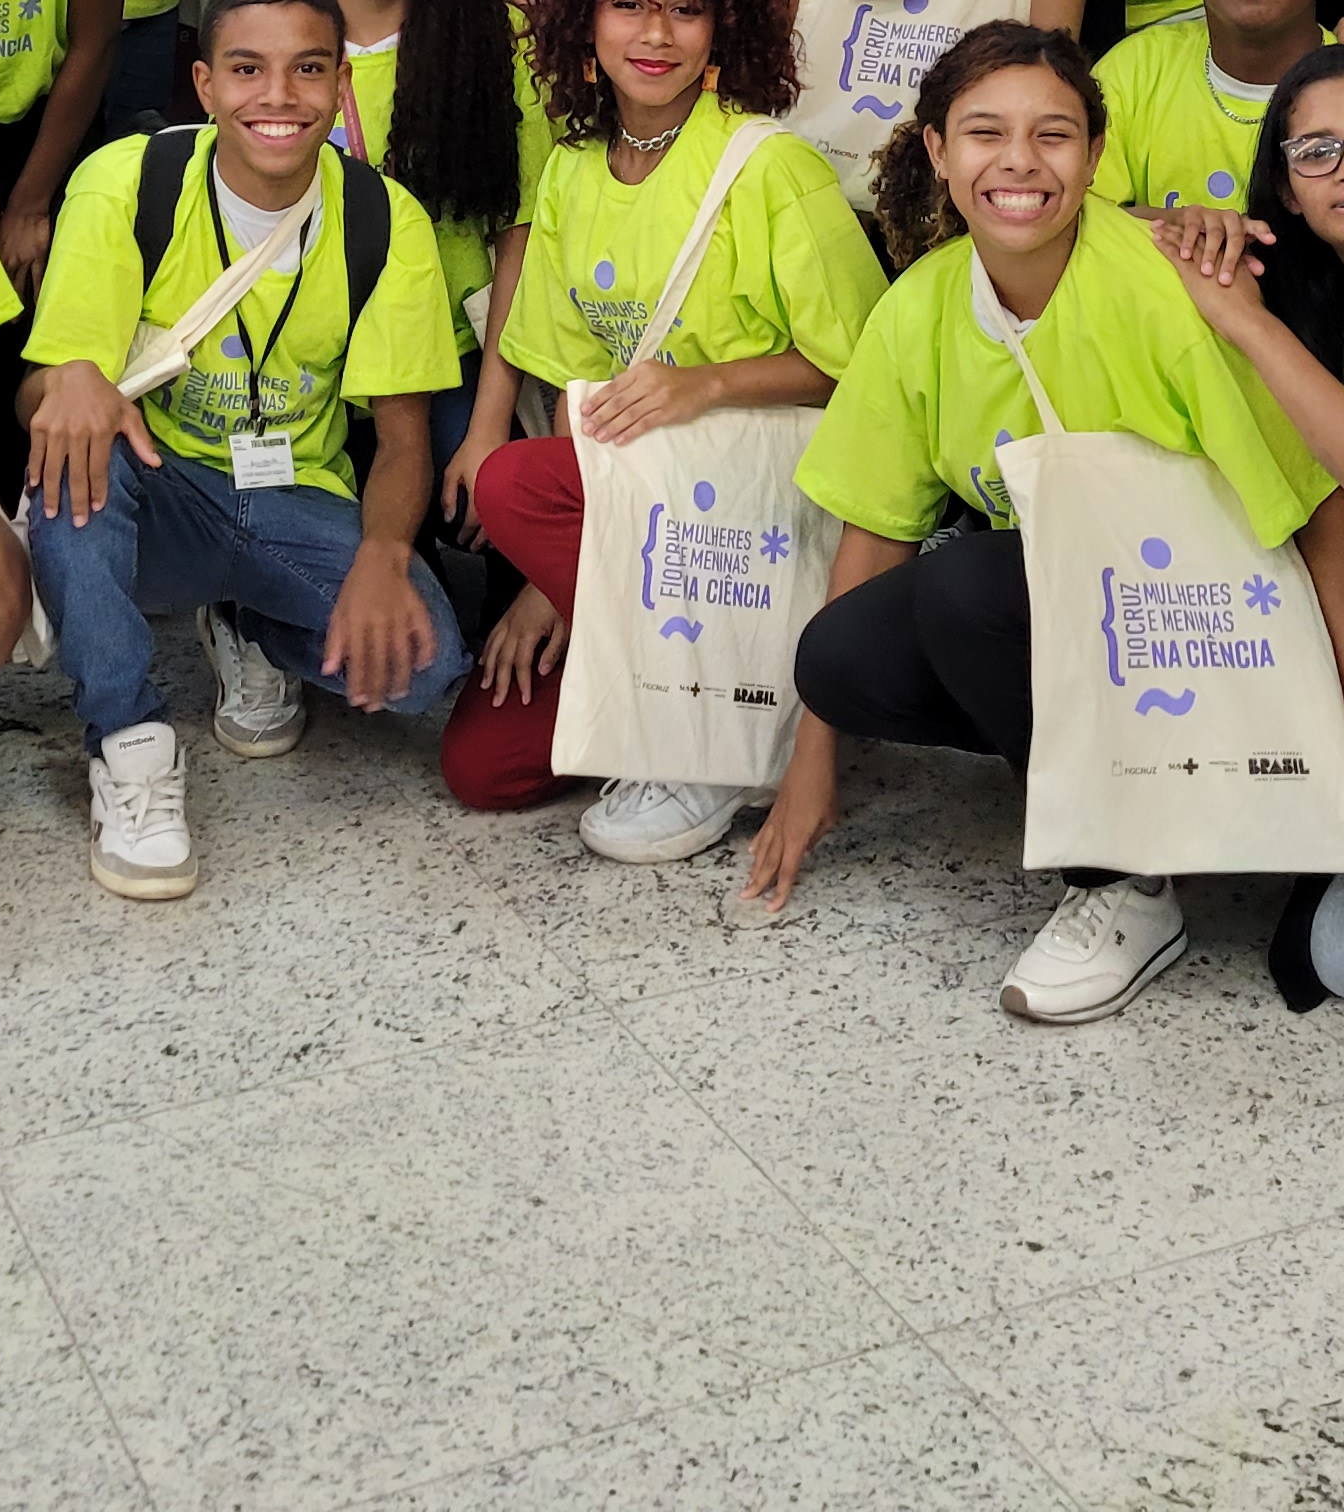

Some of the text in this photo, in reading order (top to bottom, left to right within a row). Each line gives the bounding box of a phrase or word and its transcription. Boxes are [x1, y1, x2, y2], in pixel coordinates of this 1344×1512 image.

[857, 17, 889, 83] FIOCRUZ
[884, 42, 894, 58] E
[877, 63, 902, 87] NA
[206, 391, 217, 406] E
[201, 409, 226, 431] NA
[682, 521, 752, 551] MULHERES
[660, 518, 683, 599] FIOCRUZ
[690, 549, 750, 575] MENINAS
[705, 574, 772, 610] CIÊNCIA
[1143, 583, 1232, 606] MULHERES
[1120, 582, 1150, 669] FIOCRUZ
[1148, 609, 1235, 633] E MENINAS
[1151, 633, 1275, 669] NA CIÊNCIA
[733, 687, 778, 706] BRASIL
[1248, 758, 1310, 775] BRASIL
